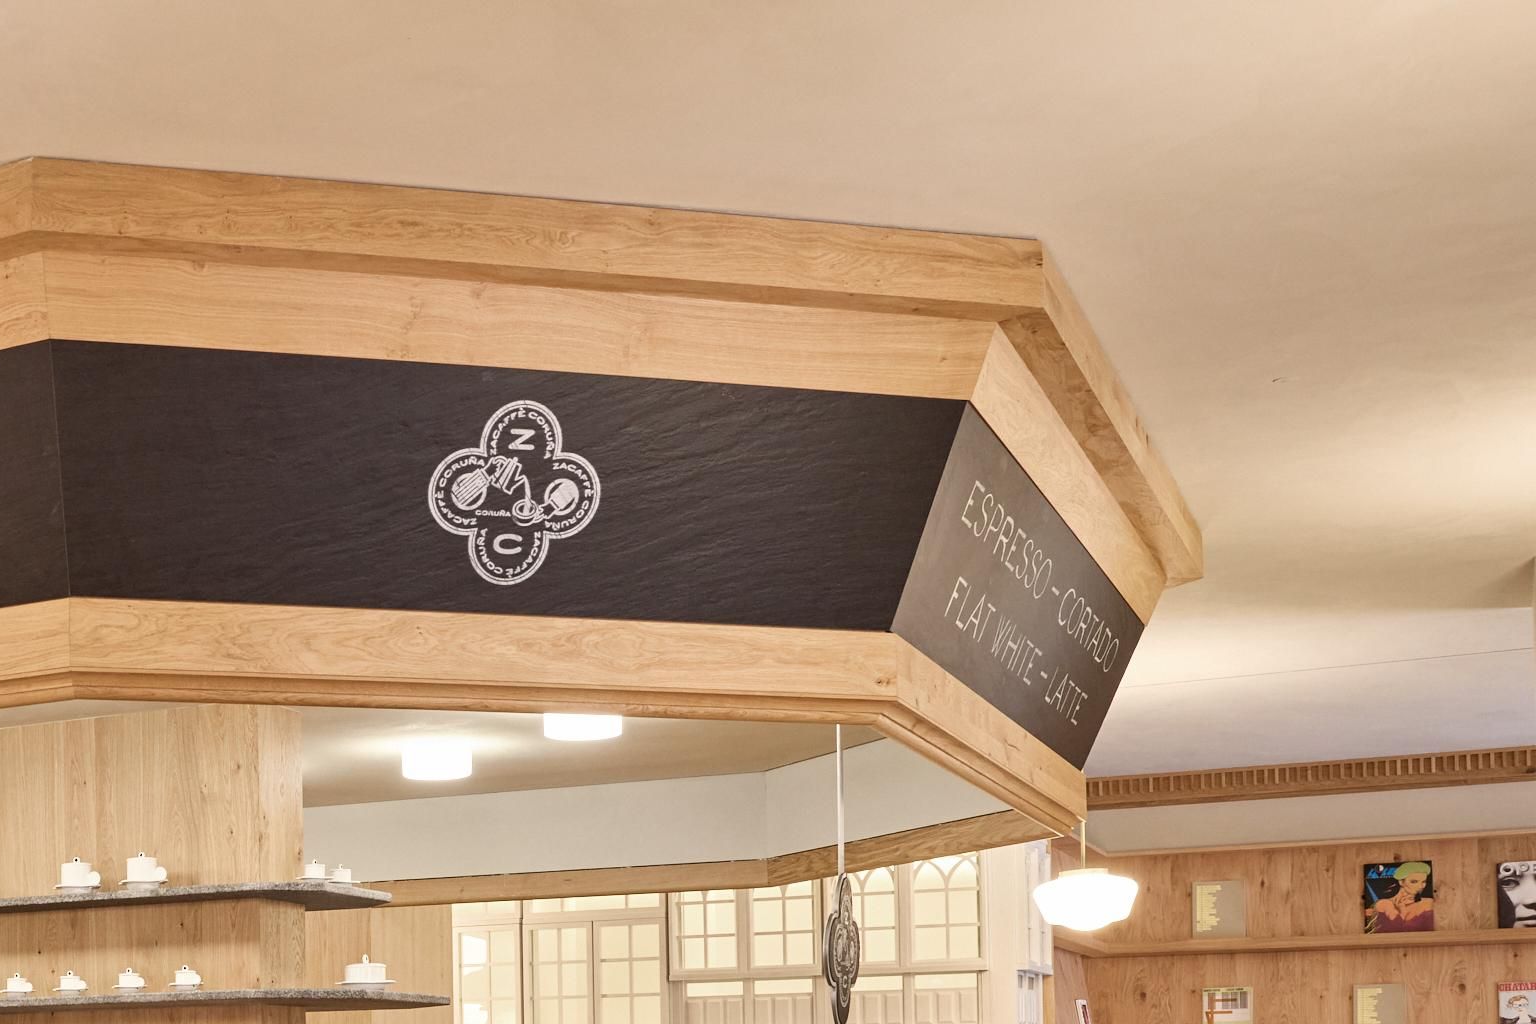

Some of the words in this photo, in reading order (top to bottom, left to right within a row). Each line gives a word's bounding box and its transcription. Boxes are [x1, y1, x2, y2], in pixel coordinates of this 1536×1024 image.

[508, 428, 536, 450] Z
[528, 411, 555, 459] CORUÑA
[439, 456, 485, 487] CORUÑA
[493, 533, 523, 555] C
[961, 480, 1052, 599] ESPRESSO
[1058, 588, 1120, 672] CORTADO
[944, 576, 996, 643] FLAT
[991, 615, 1043, 685] WHITE
[1044, 666, 1089, 726] LATTE
